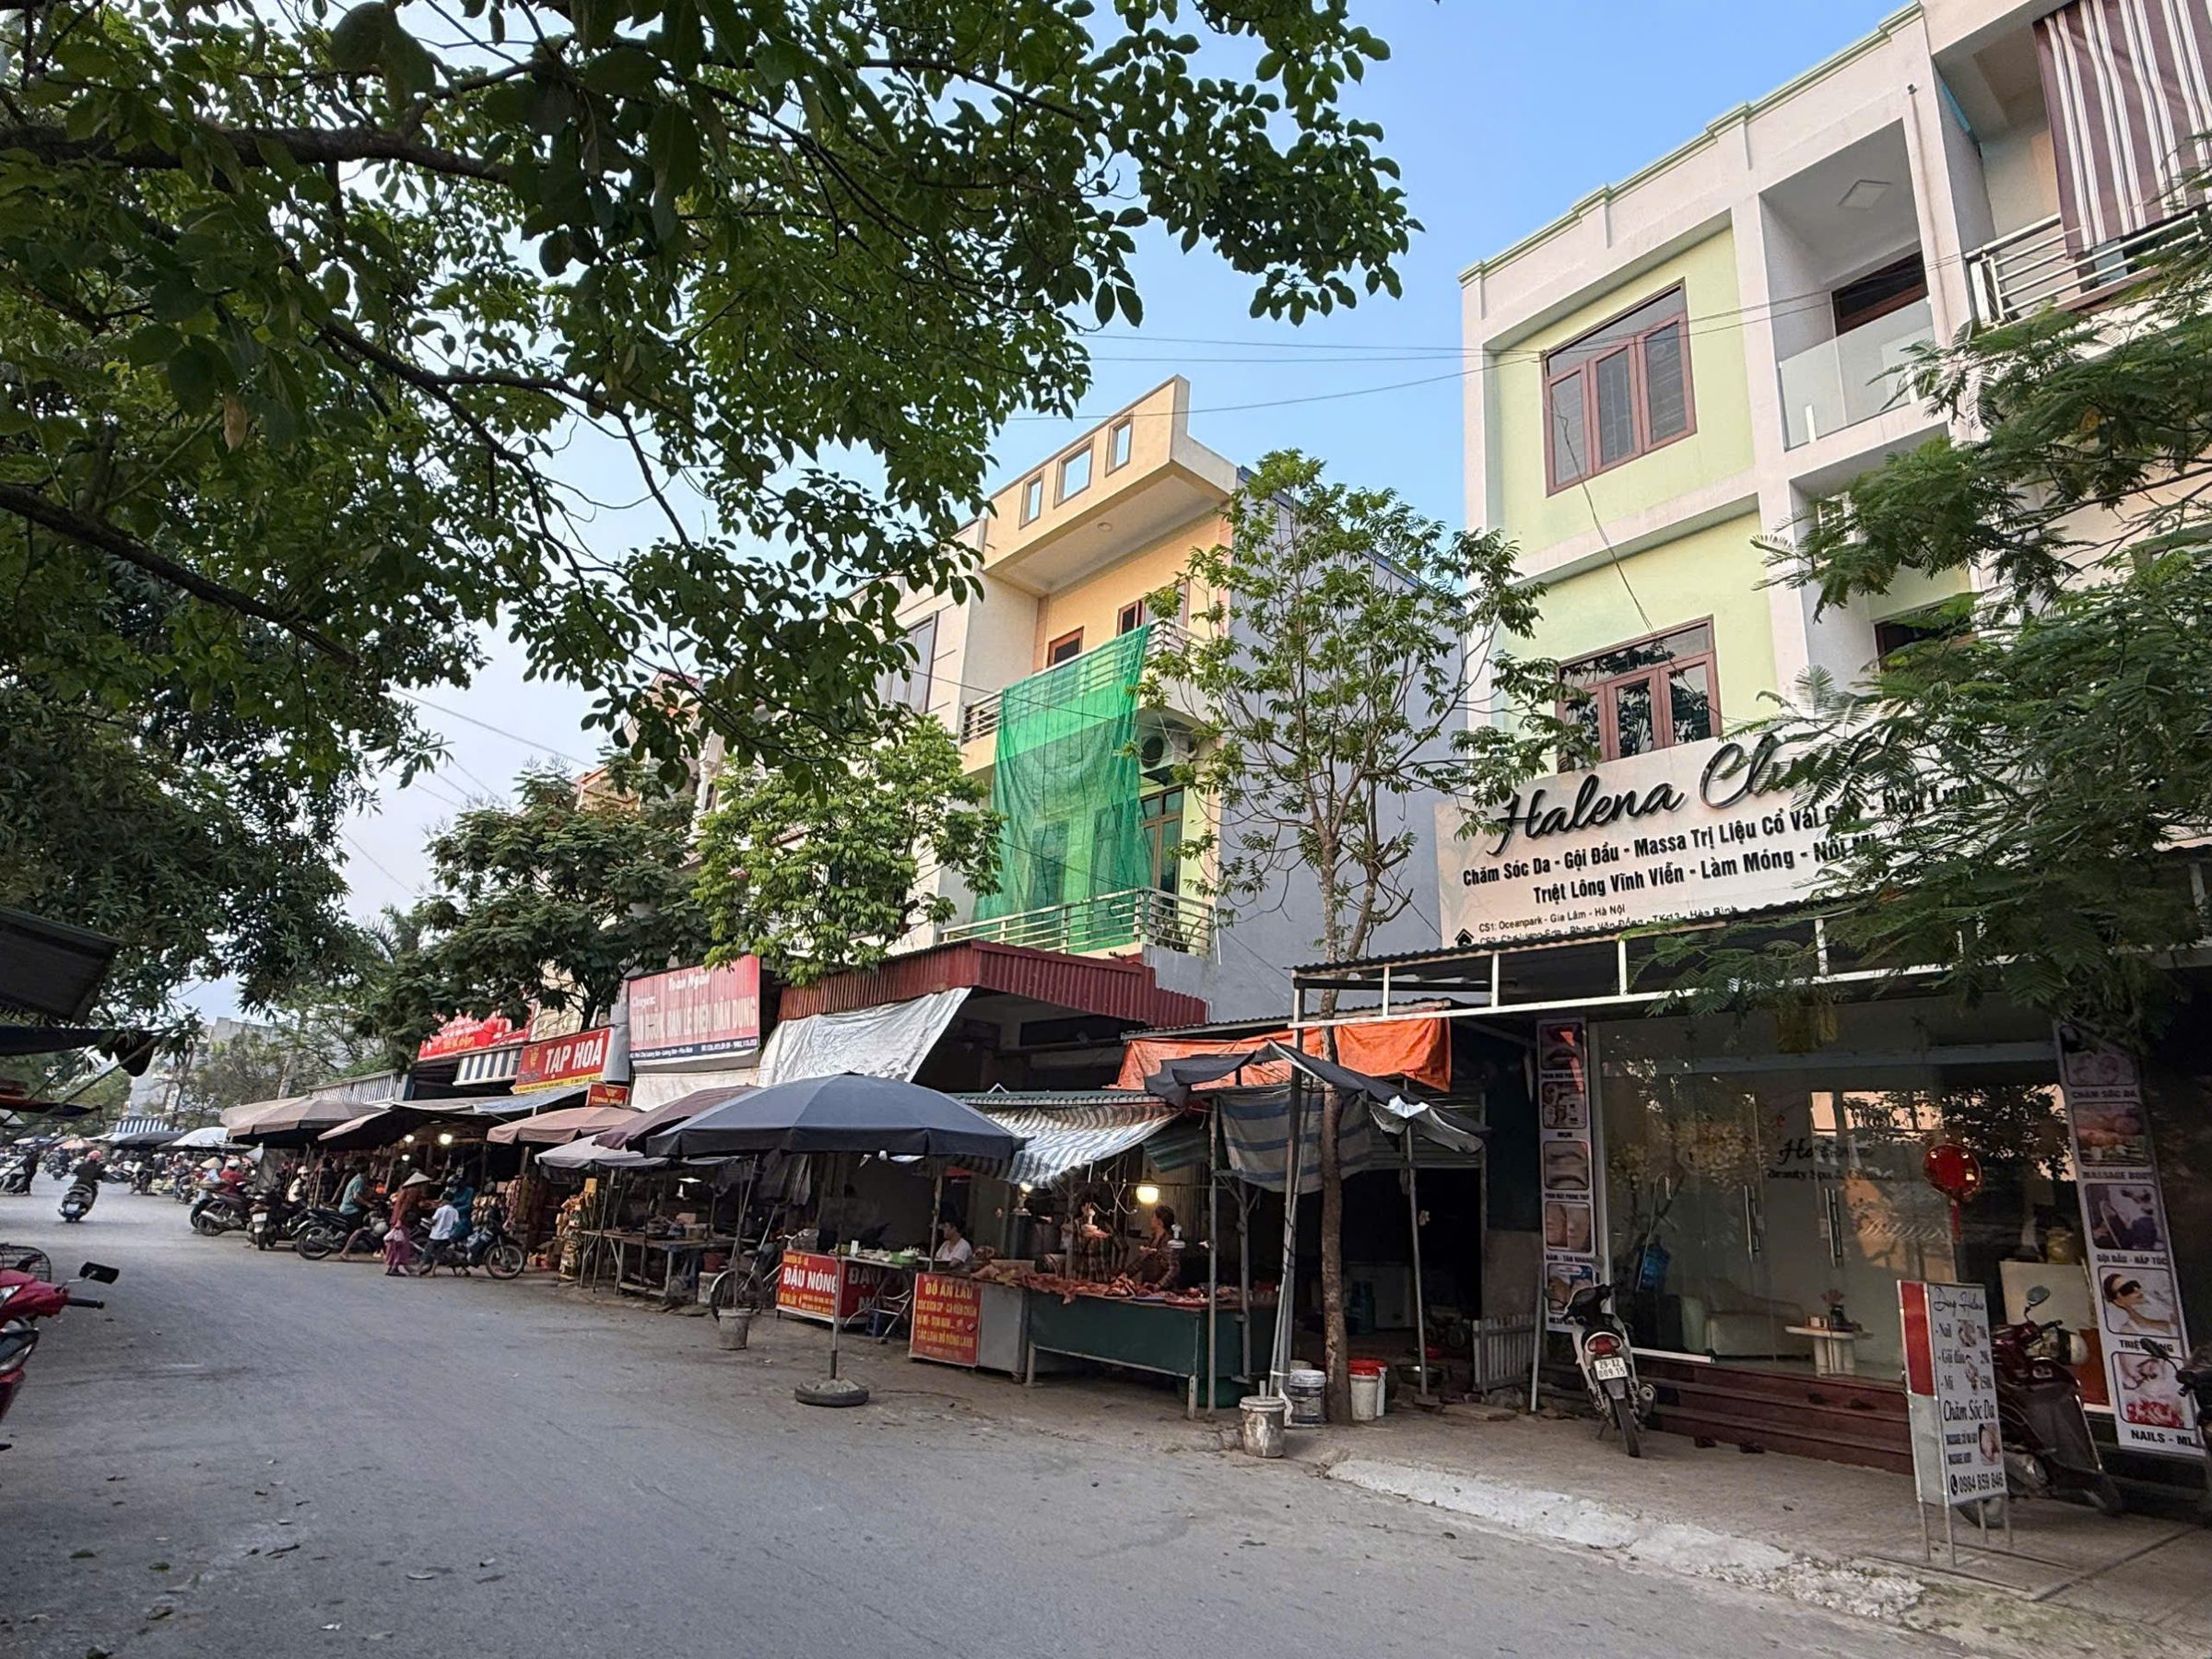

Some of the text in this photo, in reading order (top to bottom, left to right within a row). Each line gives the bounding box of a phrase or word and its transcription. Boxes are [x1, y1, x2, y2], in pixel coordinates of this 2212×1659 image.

[1486, 774, 1686, 857] Halena
[1463, 865, 1500, 887] Chăm
[1503, 860, 1530, 880] Sóc
[1534, 858, 1551, 875] Da
[1564, 849, 1587, 872] Gội
[1591, 841, 1620, 865] Đầu
[1634, 834, 1688, 858] Massa
[1690, 828, 1714, 850] Trị
[1718, 820, 1758, 846] Liệu
[1534, 885, 1567, 905] Triệt
[1571, 878, 1606, 899] Lông
[1610, 872, 1645, 888] Vĩnh
[1648, 862, 1685, 887] Viễn
[1700, 857, 1738, 879] Làm
[1743, 848, 1795, 873] Móng
[1478, 903, 1626, 933] CS1: Oceanpark Gia Lâm Hà Nội
[544, 1031, 605, 1079] TẠP HOÁ
[783, 1265, 806, 1290] ĐẬU
[1969, 1399, 1983, 1420] Sóc
[1984, 1398, 1995, 1420] Da
[2130, 1430, 2166, 1443] NAILS
